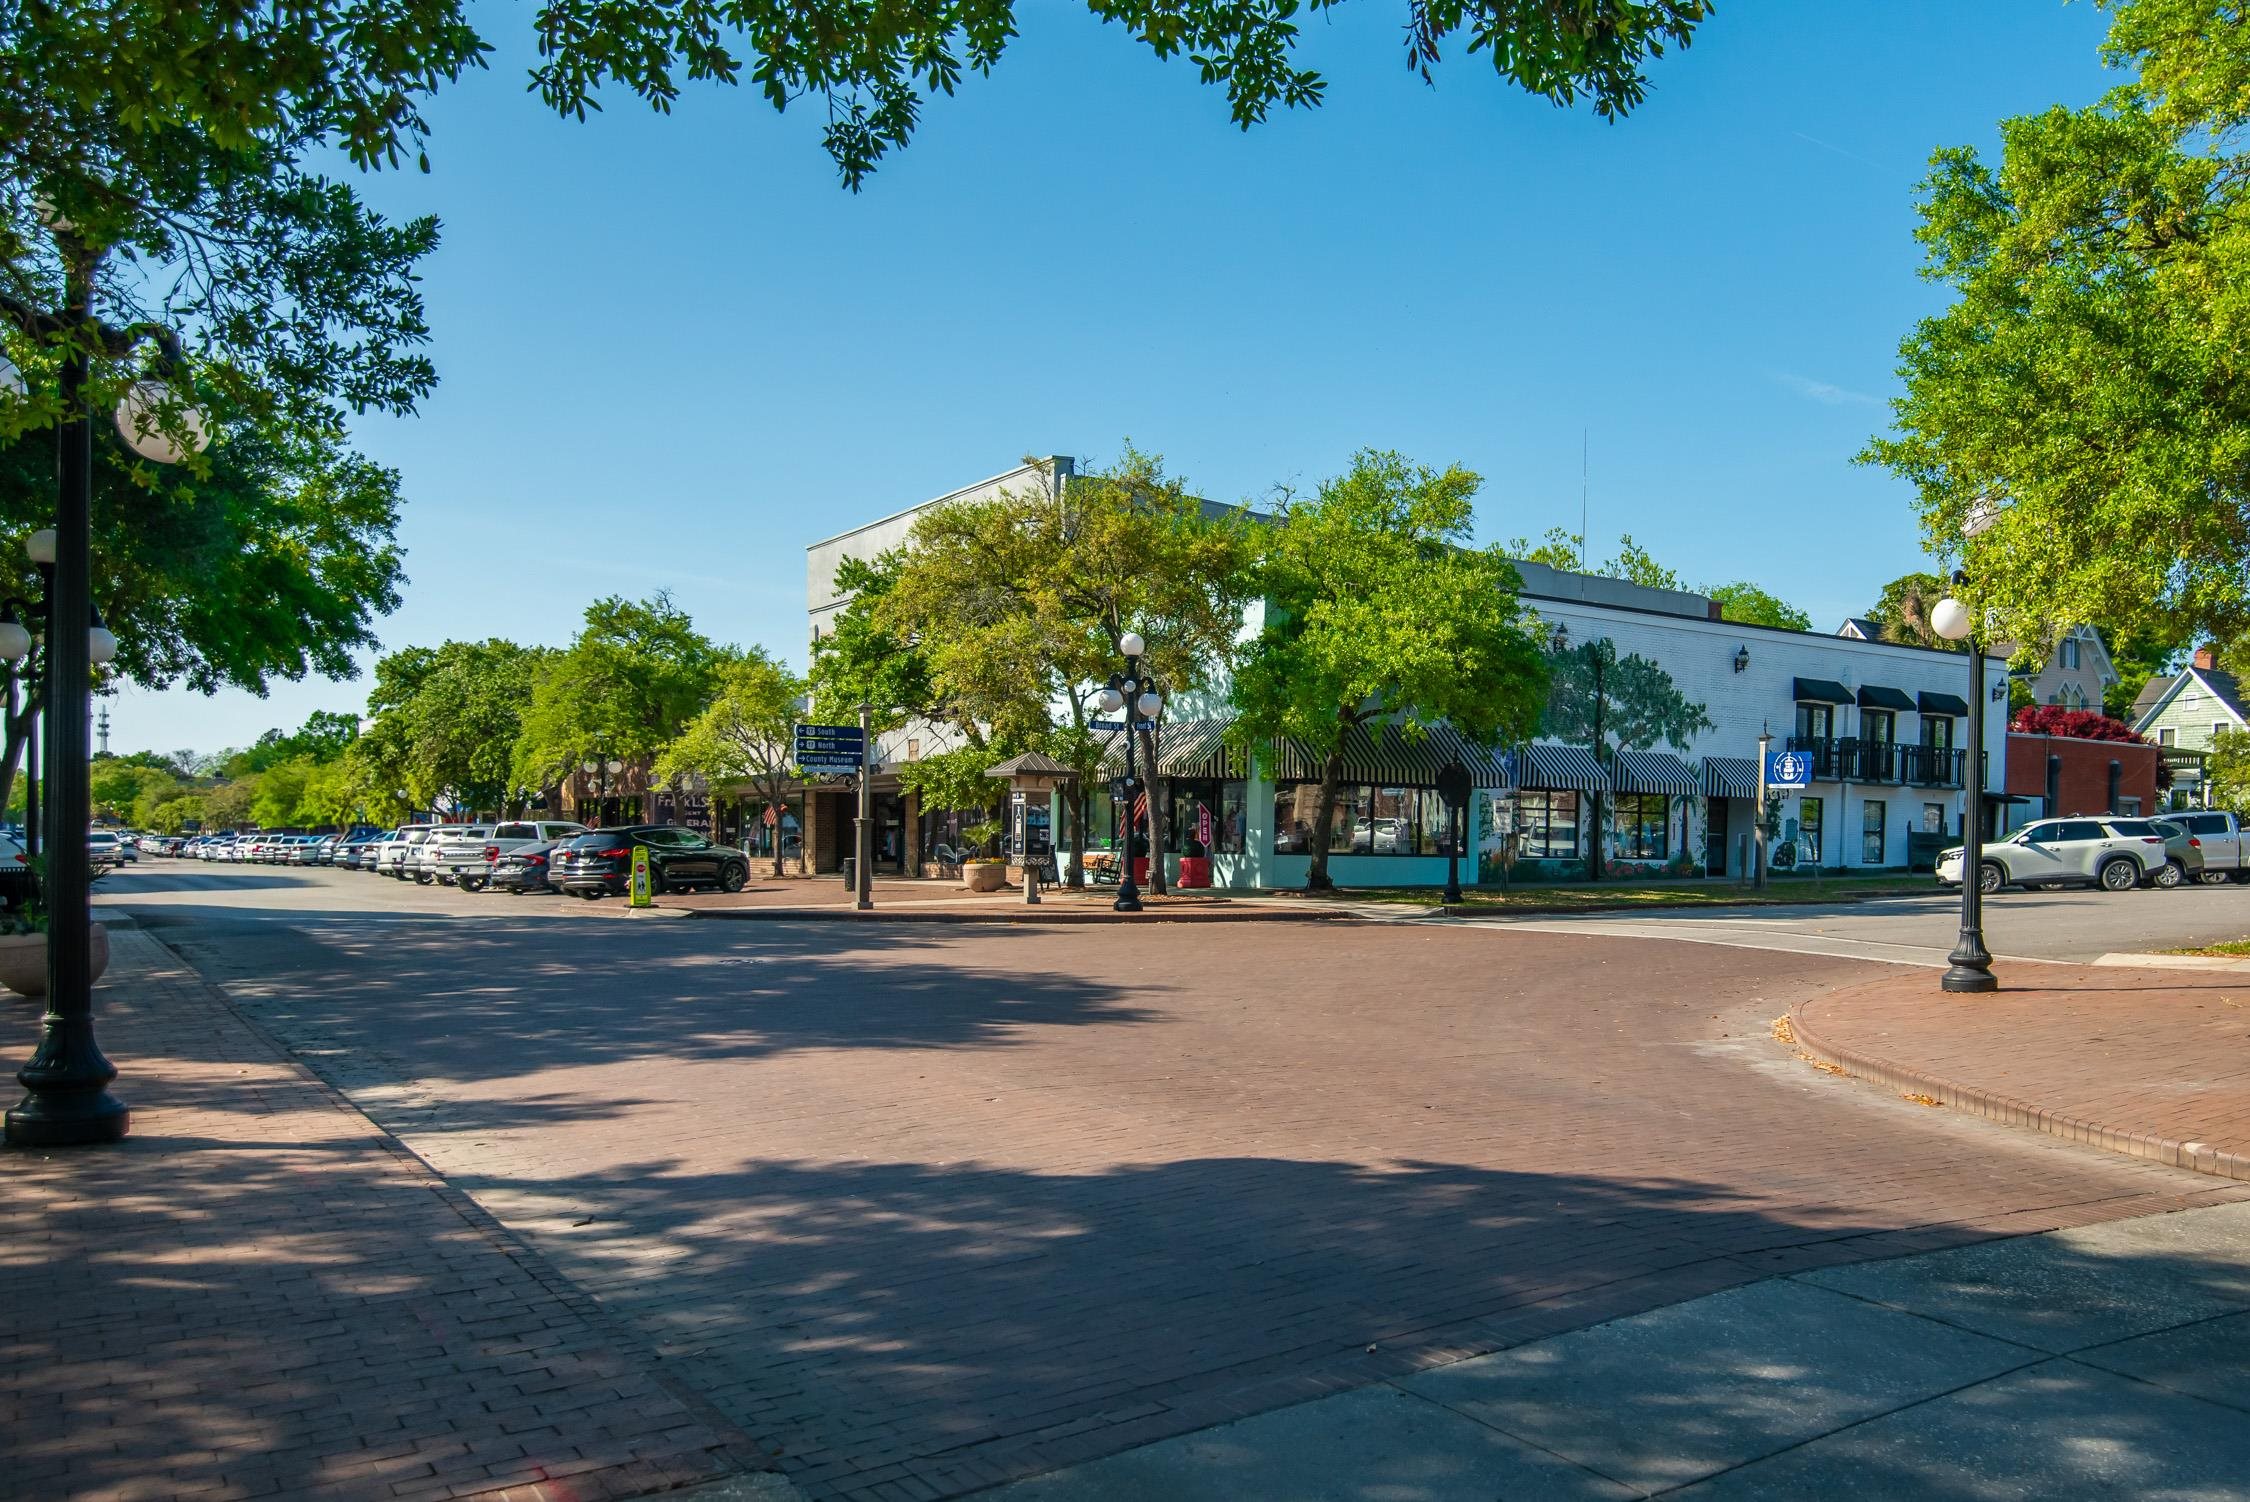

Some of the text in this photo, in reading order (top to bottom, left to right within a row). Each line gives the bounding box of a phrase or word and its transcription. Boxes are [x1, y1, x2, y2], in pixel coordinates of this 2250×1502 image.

[1095, 721, 1112, 729] Broad
[817, 727, 836, 735] South
[817, 741, 836, 750] North
[805, 755, 854, 764] County Museum
[658, 795, 690, 807] Frak
[1201, 812, 1209, 841] OPEN
